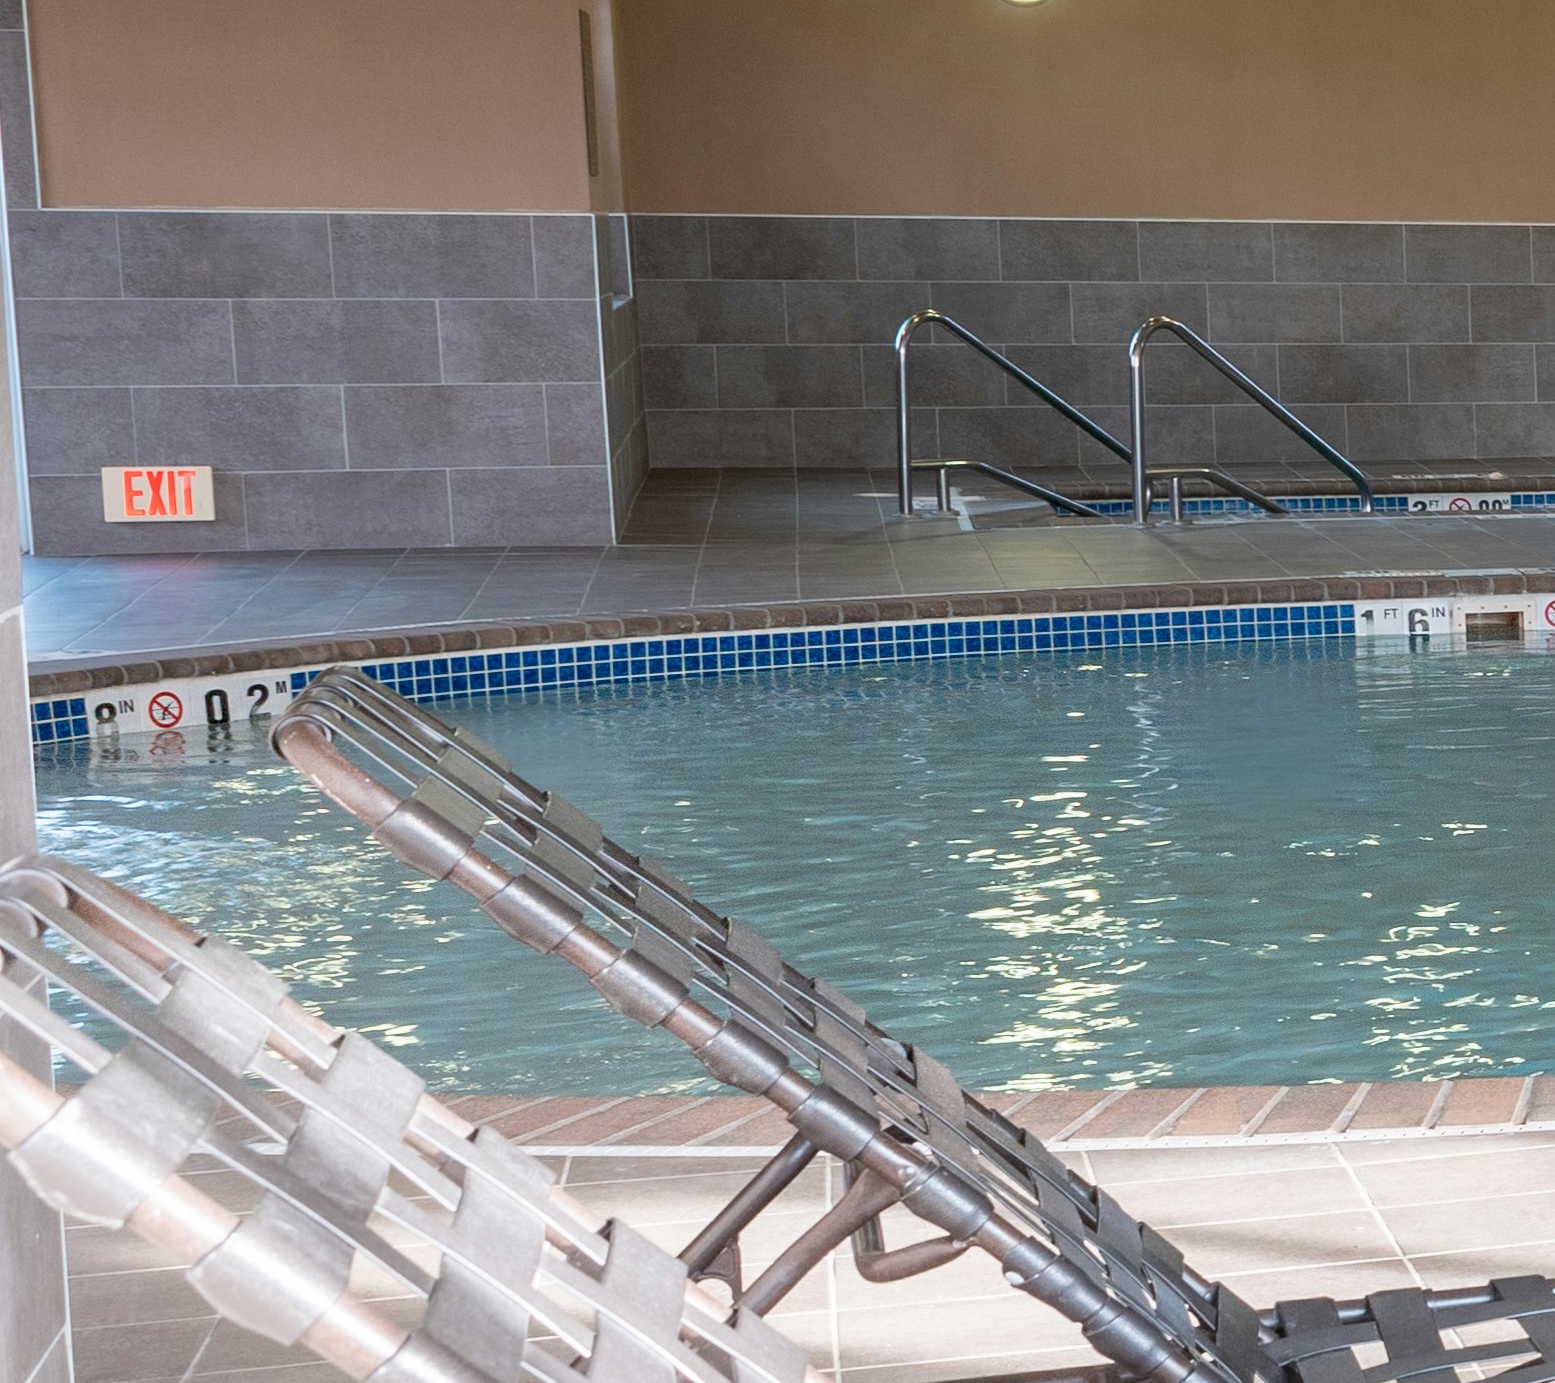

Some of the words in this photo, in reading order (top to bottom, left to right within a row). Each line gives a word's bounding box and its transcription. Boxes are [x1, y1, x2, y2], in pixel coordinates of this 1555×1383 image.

[122, 470, 197, 517] EXIT
[1384, 608, 1398, 619] FT
[1408, 608, 1431, 633] 6
[1431, 607, 1445, 618] IN
[119, 699, 134, 714] IN
